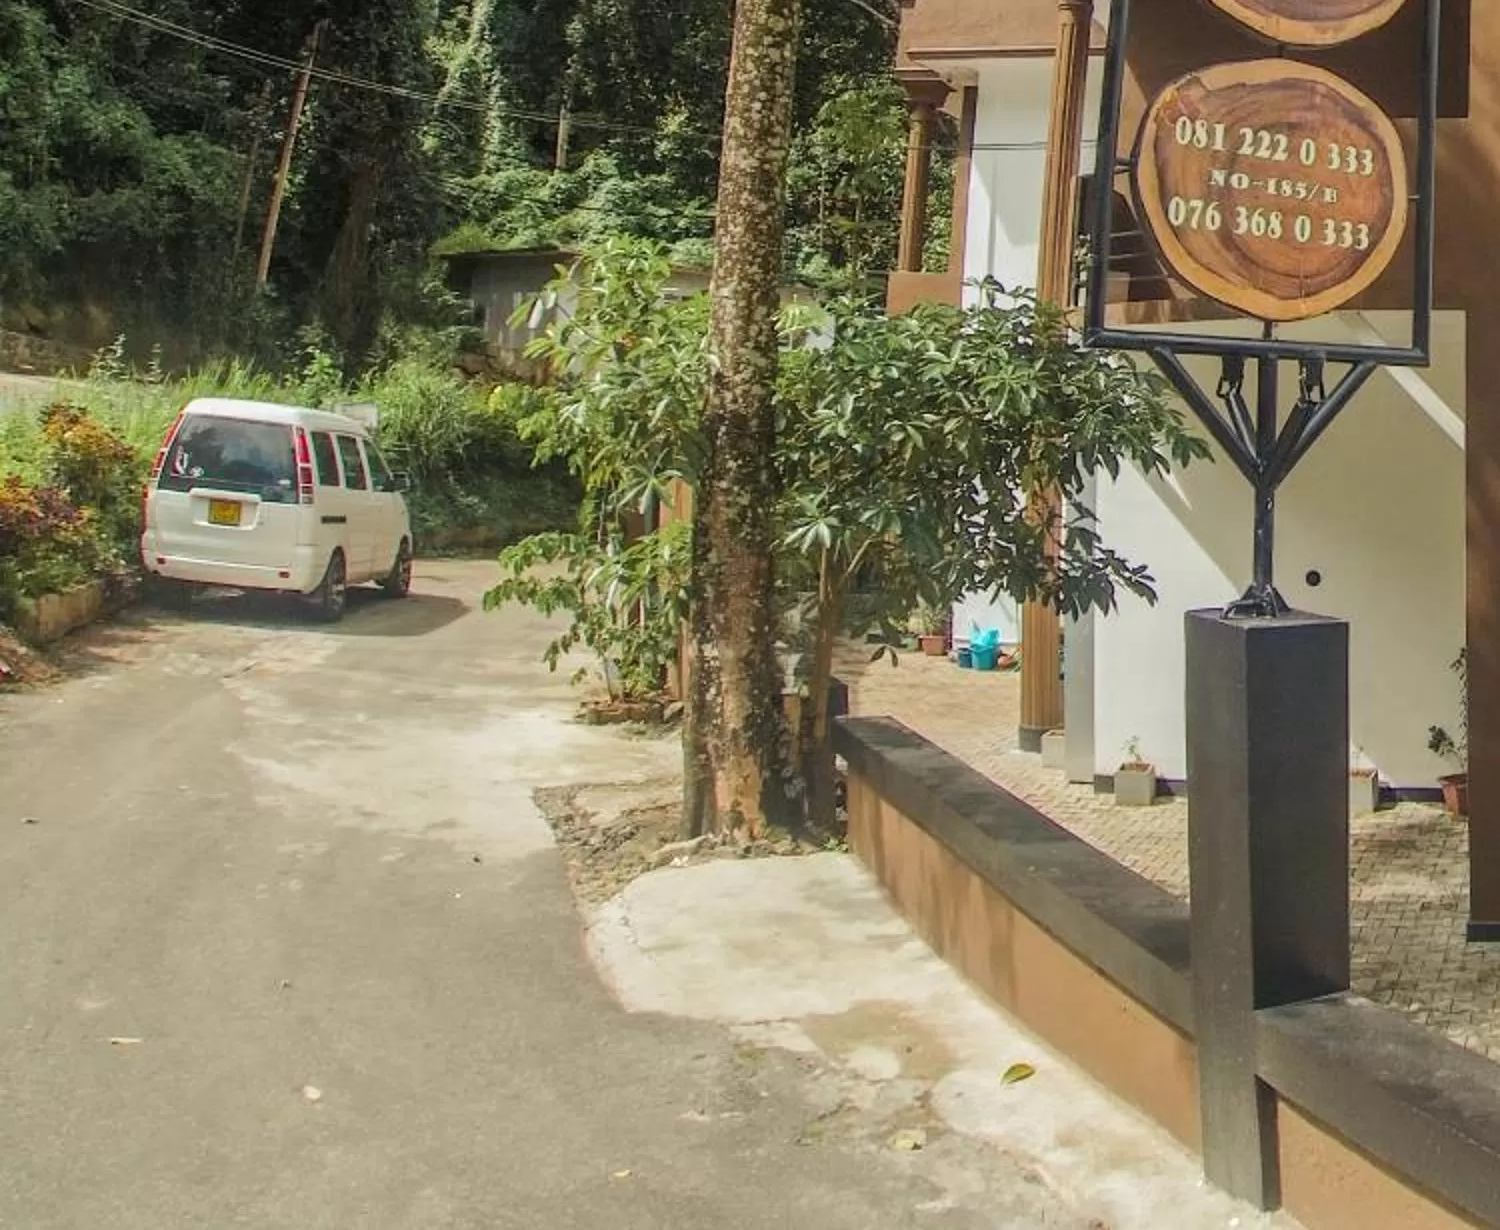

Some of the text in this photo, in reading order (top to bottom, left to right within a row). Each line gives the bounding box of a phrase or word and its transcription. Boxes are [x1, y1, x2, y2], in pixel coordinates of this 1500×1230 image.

[1175, 116, 1374, 175] 081 222 0 333
[1167, 196, 1369, 250] 076 368 0 333
